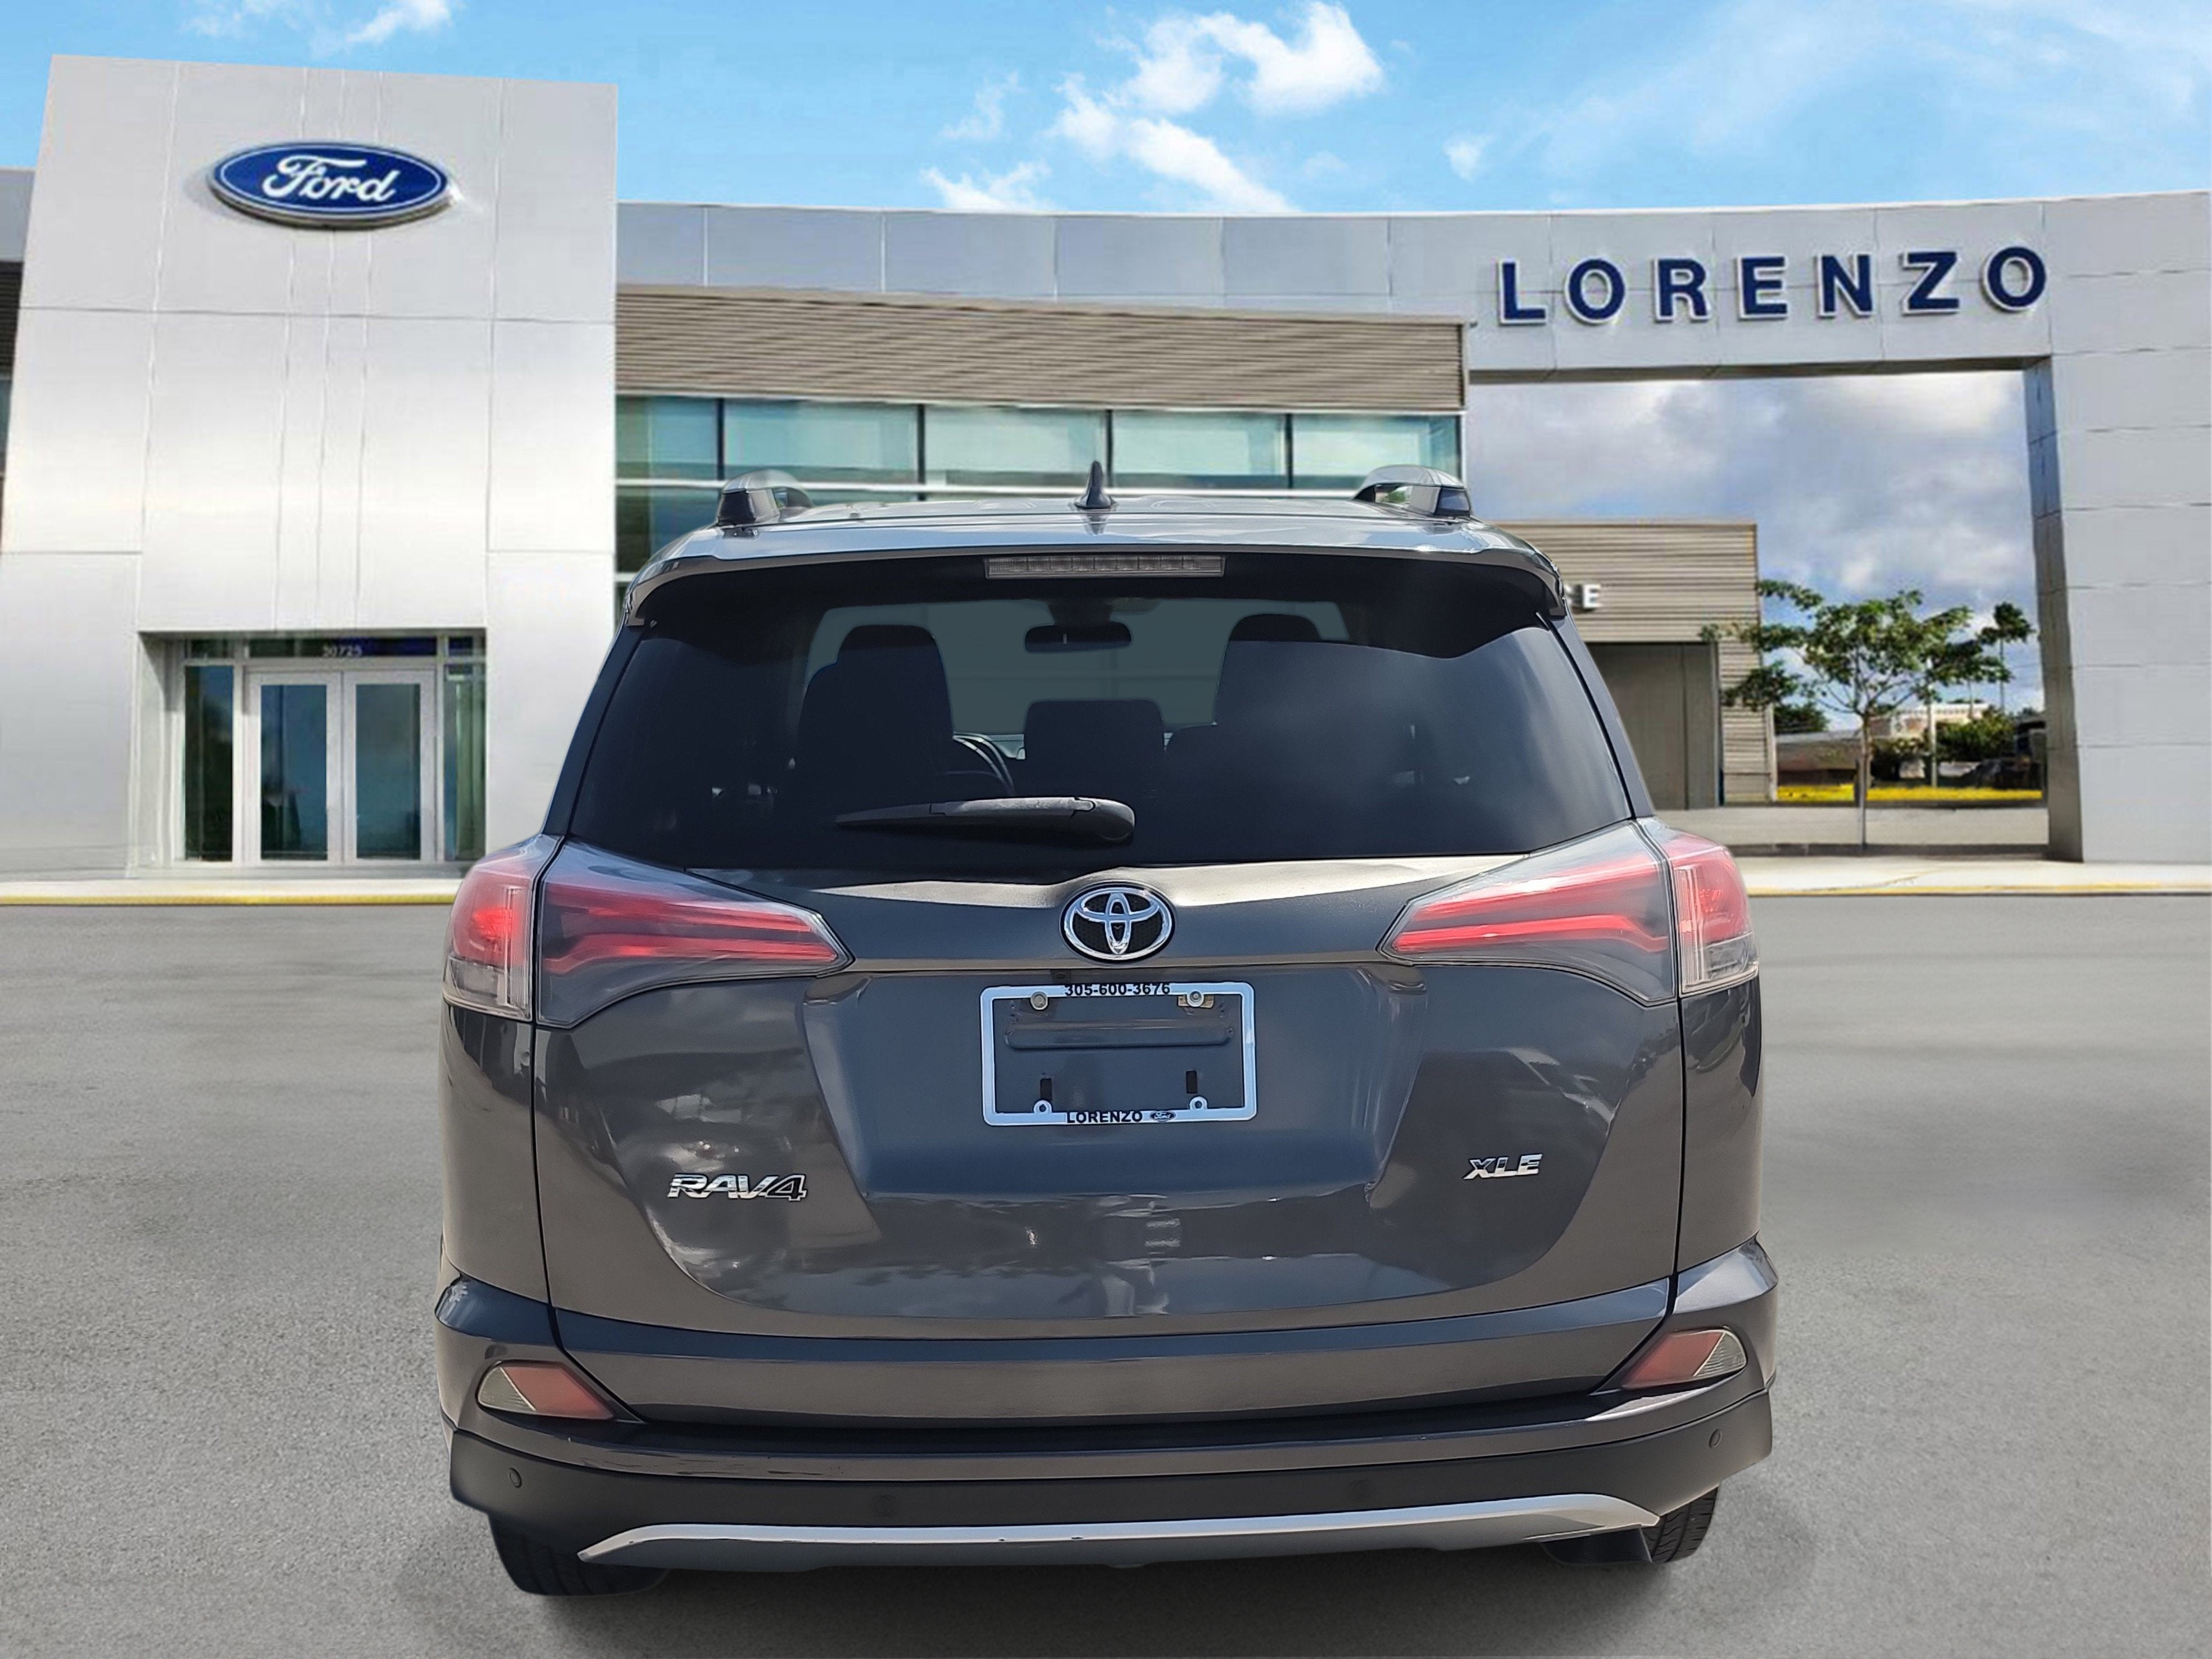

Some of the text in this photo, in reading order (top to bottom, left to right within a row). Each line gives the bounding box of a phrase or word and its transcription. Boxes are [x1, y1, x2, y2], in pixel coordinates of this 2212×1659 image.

[262, 154, 399, 202] Ford
[1498, 246, 2047, 325] LORENZO
[1064, 983, 1170, 996] 305-600-3676
[1068, 1110, 1143, 1123] LORENZO
[1462, 1153, 1542, 1180] XLE
[667, 1174, 807, 1202] RAV4
